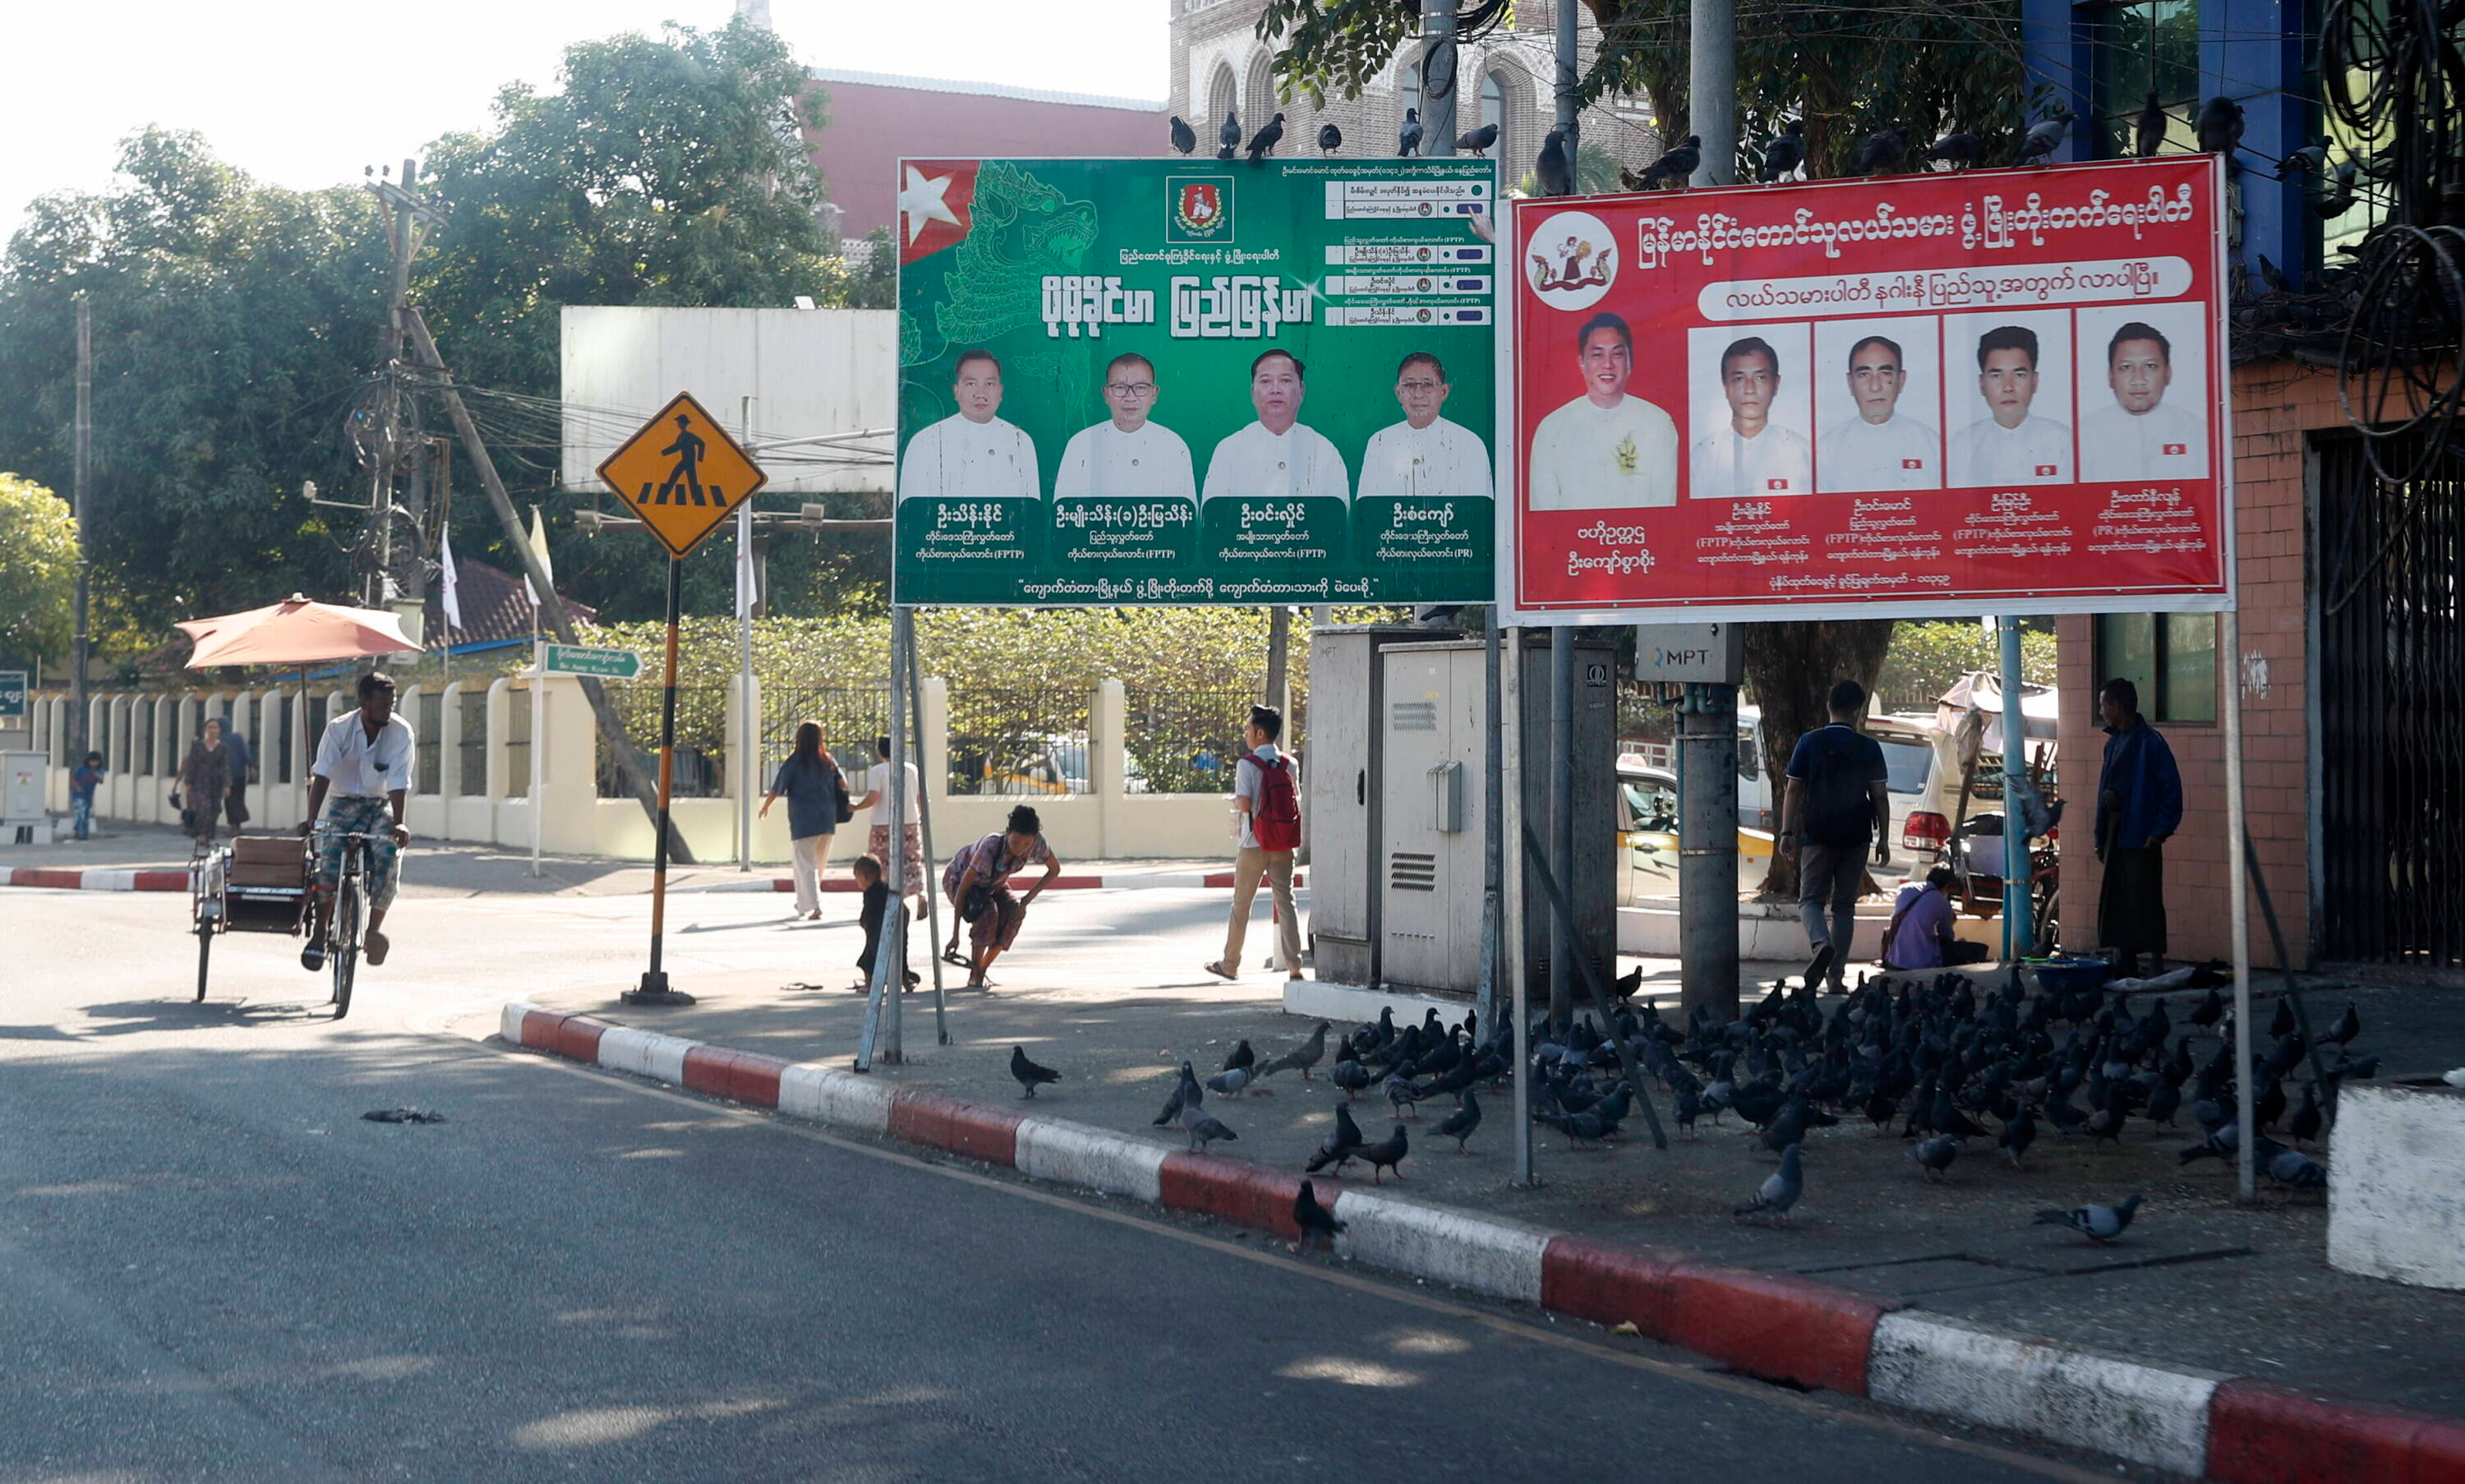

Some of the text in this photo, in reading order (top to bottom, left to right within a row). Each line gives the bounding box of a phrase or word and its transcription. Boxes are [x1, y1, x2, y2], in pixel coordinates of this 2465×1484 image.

[1638, 183, 2193, 269] မြန်မာနိုင်ငံတောင်သူလယ်သမား ဖွံ့ဖြိုးတိုးတက်ရေးပါတီ
[1726, 262, 2160, 309] လယ်သမားပါတီ နဂါးနီ ပြည်သူ့အတွက် လာပါပြီ။
[1042, 276, 1312, 337] ပိုမိုခိုင်မာ ပြည်မြန်မာ
[938, 504, 1002, 528] ဦးသိန်းနိုင်
[1056, 504, 1192, 528] ဦးမျိုးသိန်း(ခ)ဦးမြသိန်း
[1241, 503, 1305, 528] ဦးဝင်းလှိုင်
[1394, 503, 1454, 528] ဦးစံကျော်
[994, 549, 1025, 560] (FPTP)
[1145, 549, 1175, 560] (FPTP)
[1297, 549, 1326, 560] (FPTP)
[1454, 549, 1472, 560] (PR)
[1568, 549, 1656, 576] ဦးကျော်စွာစိုး
[1666, 650, 1709, 665] MPT
